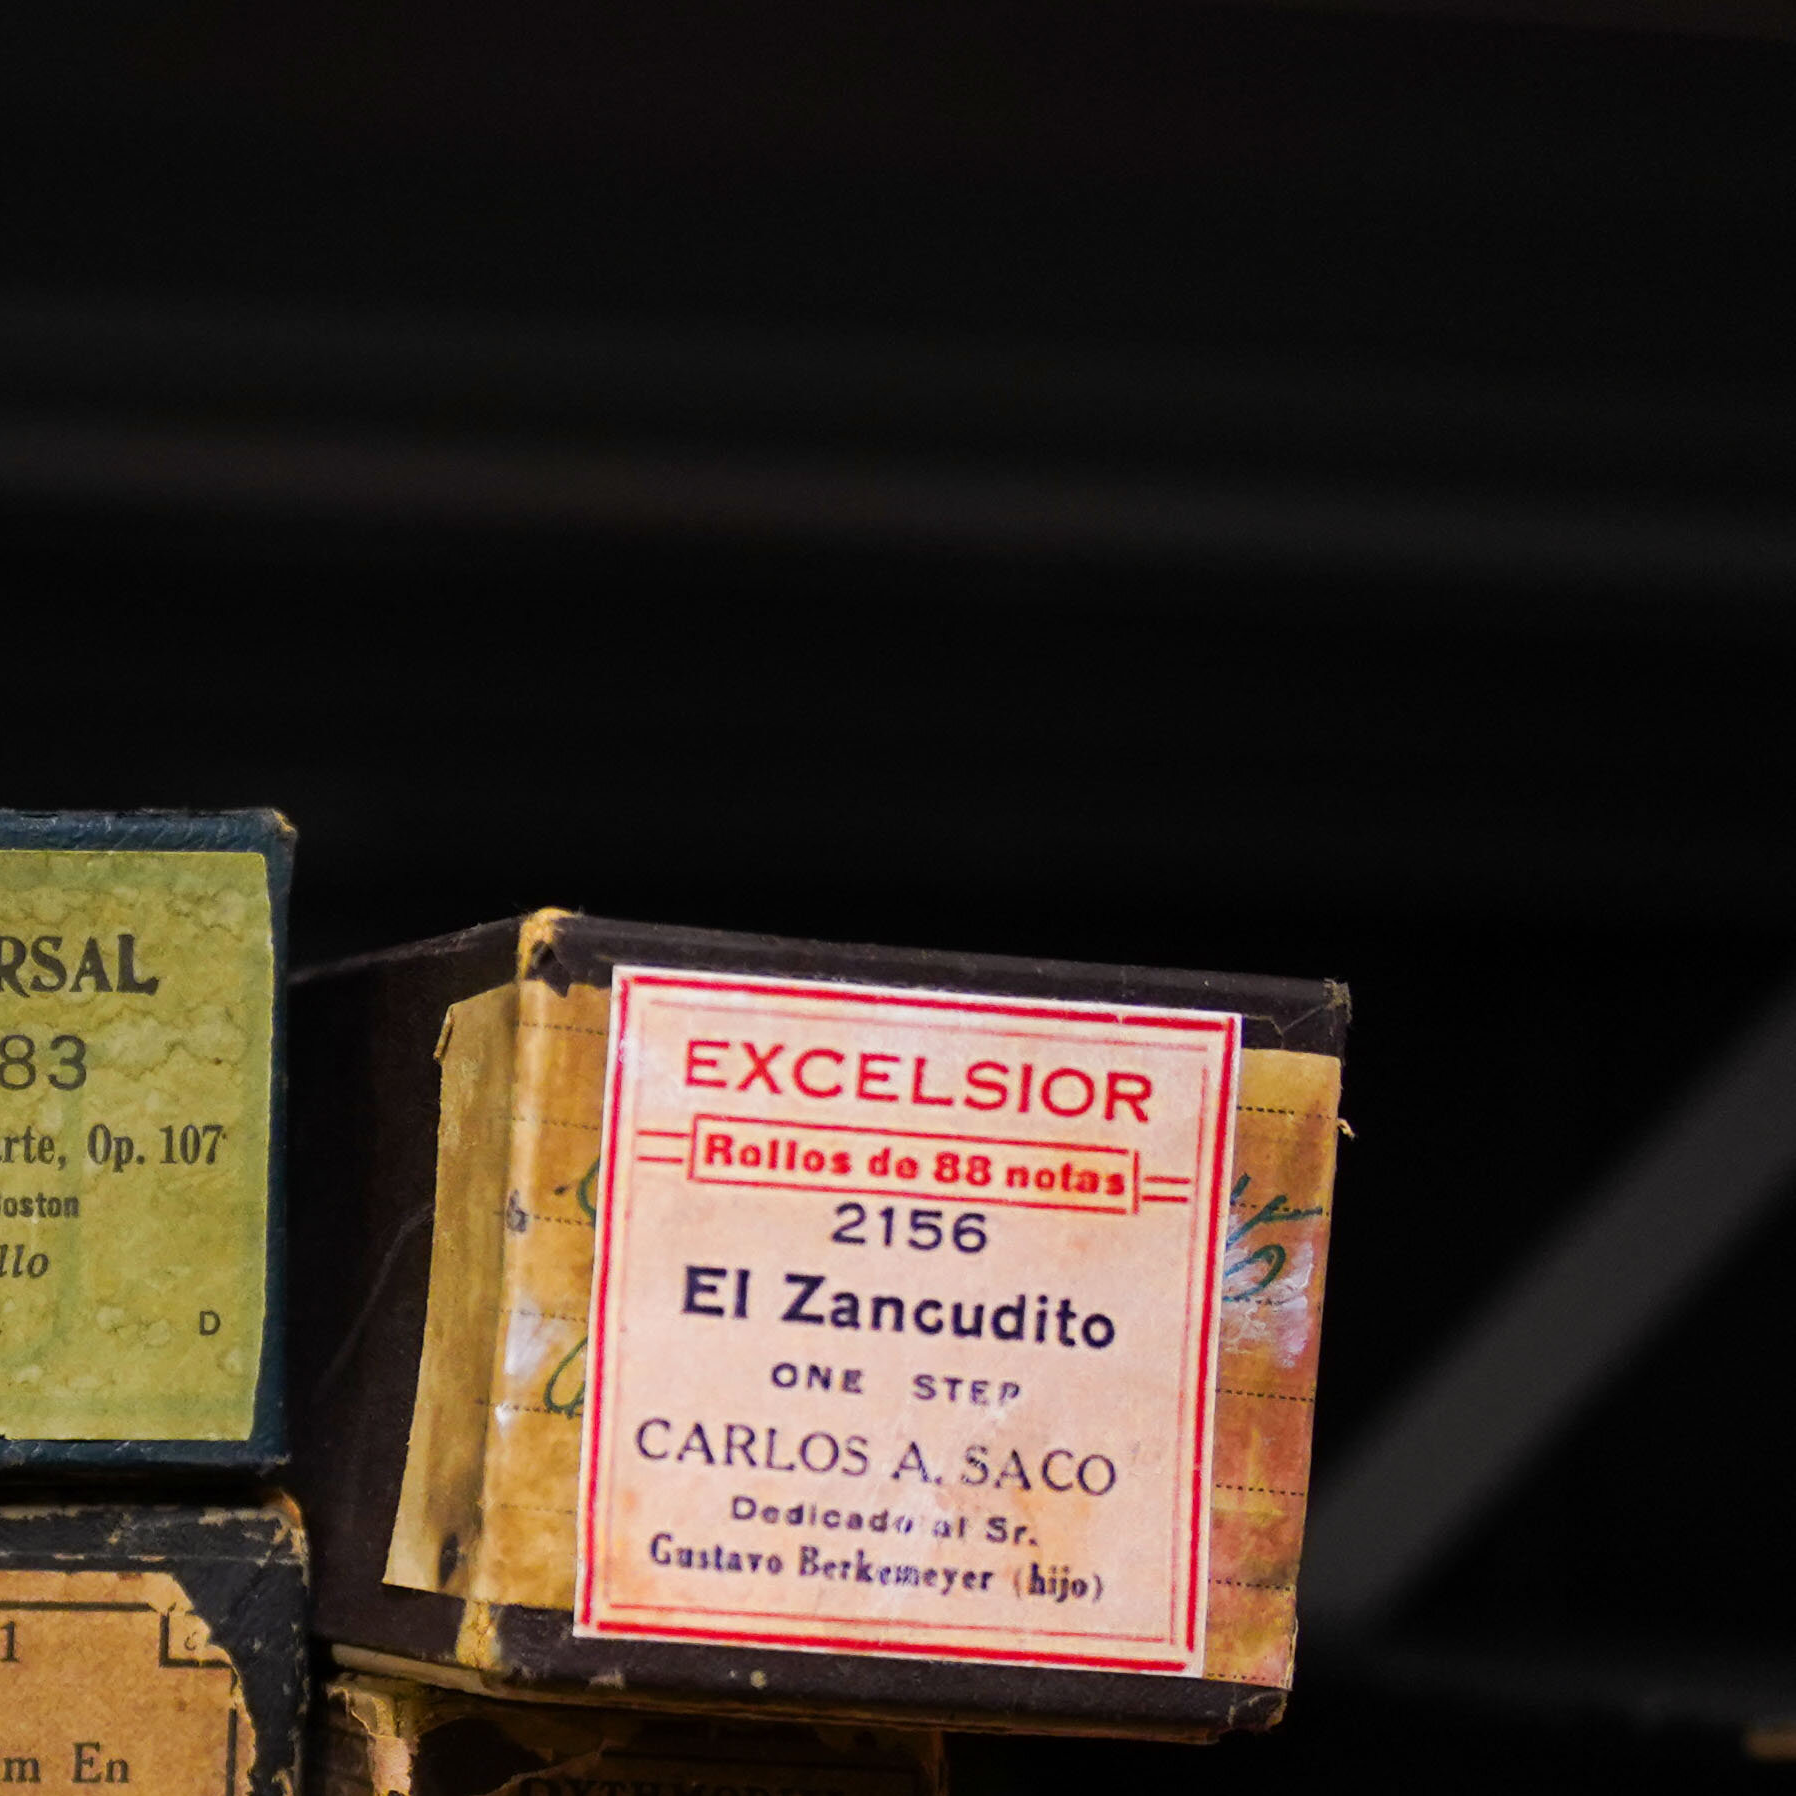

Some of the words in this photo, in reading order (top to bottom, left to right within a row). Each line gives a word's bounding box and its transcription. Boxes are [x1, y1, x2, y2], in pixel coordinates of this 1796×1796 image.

[685, 1040, 1152, 1123] EXCELSIOR
[88, 1126, 145, 1172] Op.
[161, 1126, 223, 1164] 107
[832, 1202, 988, 1252] 2156
[682, 1265, 748, 1319] El
[782, 1274, 1116, 1349] Zancudito
[772, 1362, 865, 1394] ONE
[913, 1374, 1021, 1404] STEP
[636, 1419, 869, 1476] CARLOS
[893, 1442, 943, 1485] A.
[962, 1443, 1116, 1495] SACO
[650, 1534, 783, 1576] Gustavo
[798, 1546, 993, 1593] Berkemeyer
[1015, 1562, 1103, 1601] (hijo)
